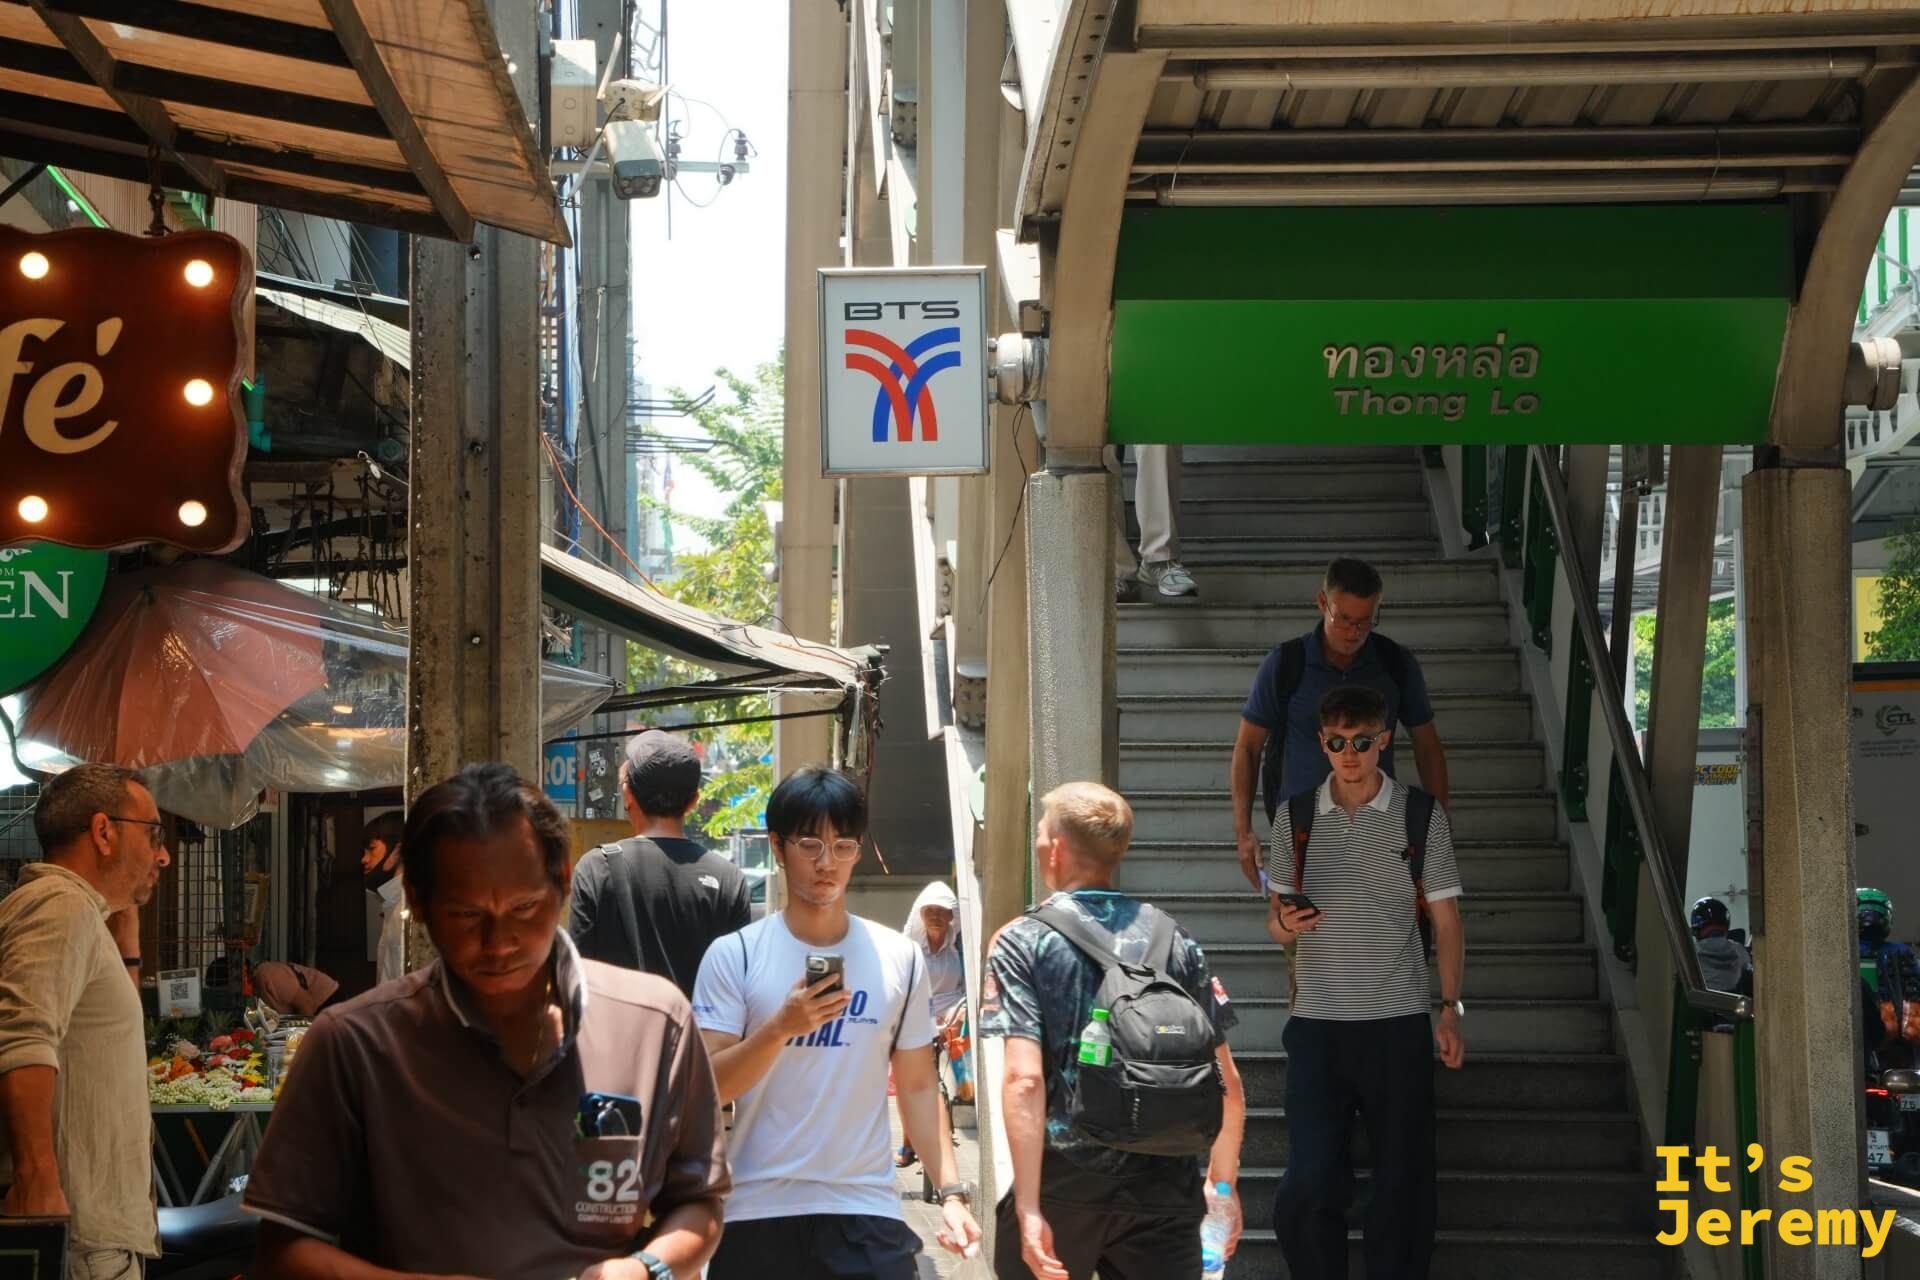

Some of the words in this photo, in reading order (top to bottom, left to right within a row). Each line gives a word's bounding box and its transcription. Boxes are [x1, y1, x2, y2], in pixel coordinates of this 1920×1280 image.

[844, 300, 960, 321] BTS
[1322, 332, 1539, 379] ทองหล่อ
[1333, 388, 1468, 421] Thong
[1489, 388, 1540, 416] Lo
[586, 1158, 640, 1202] 82
